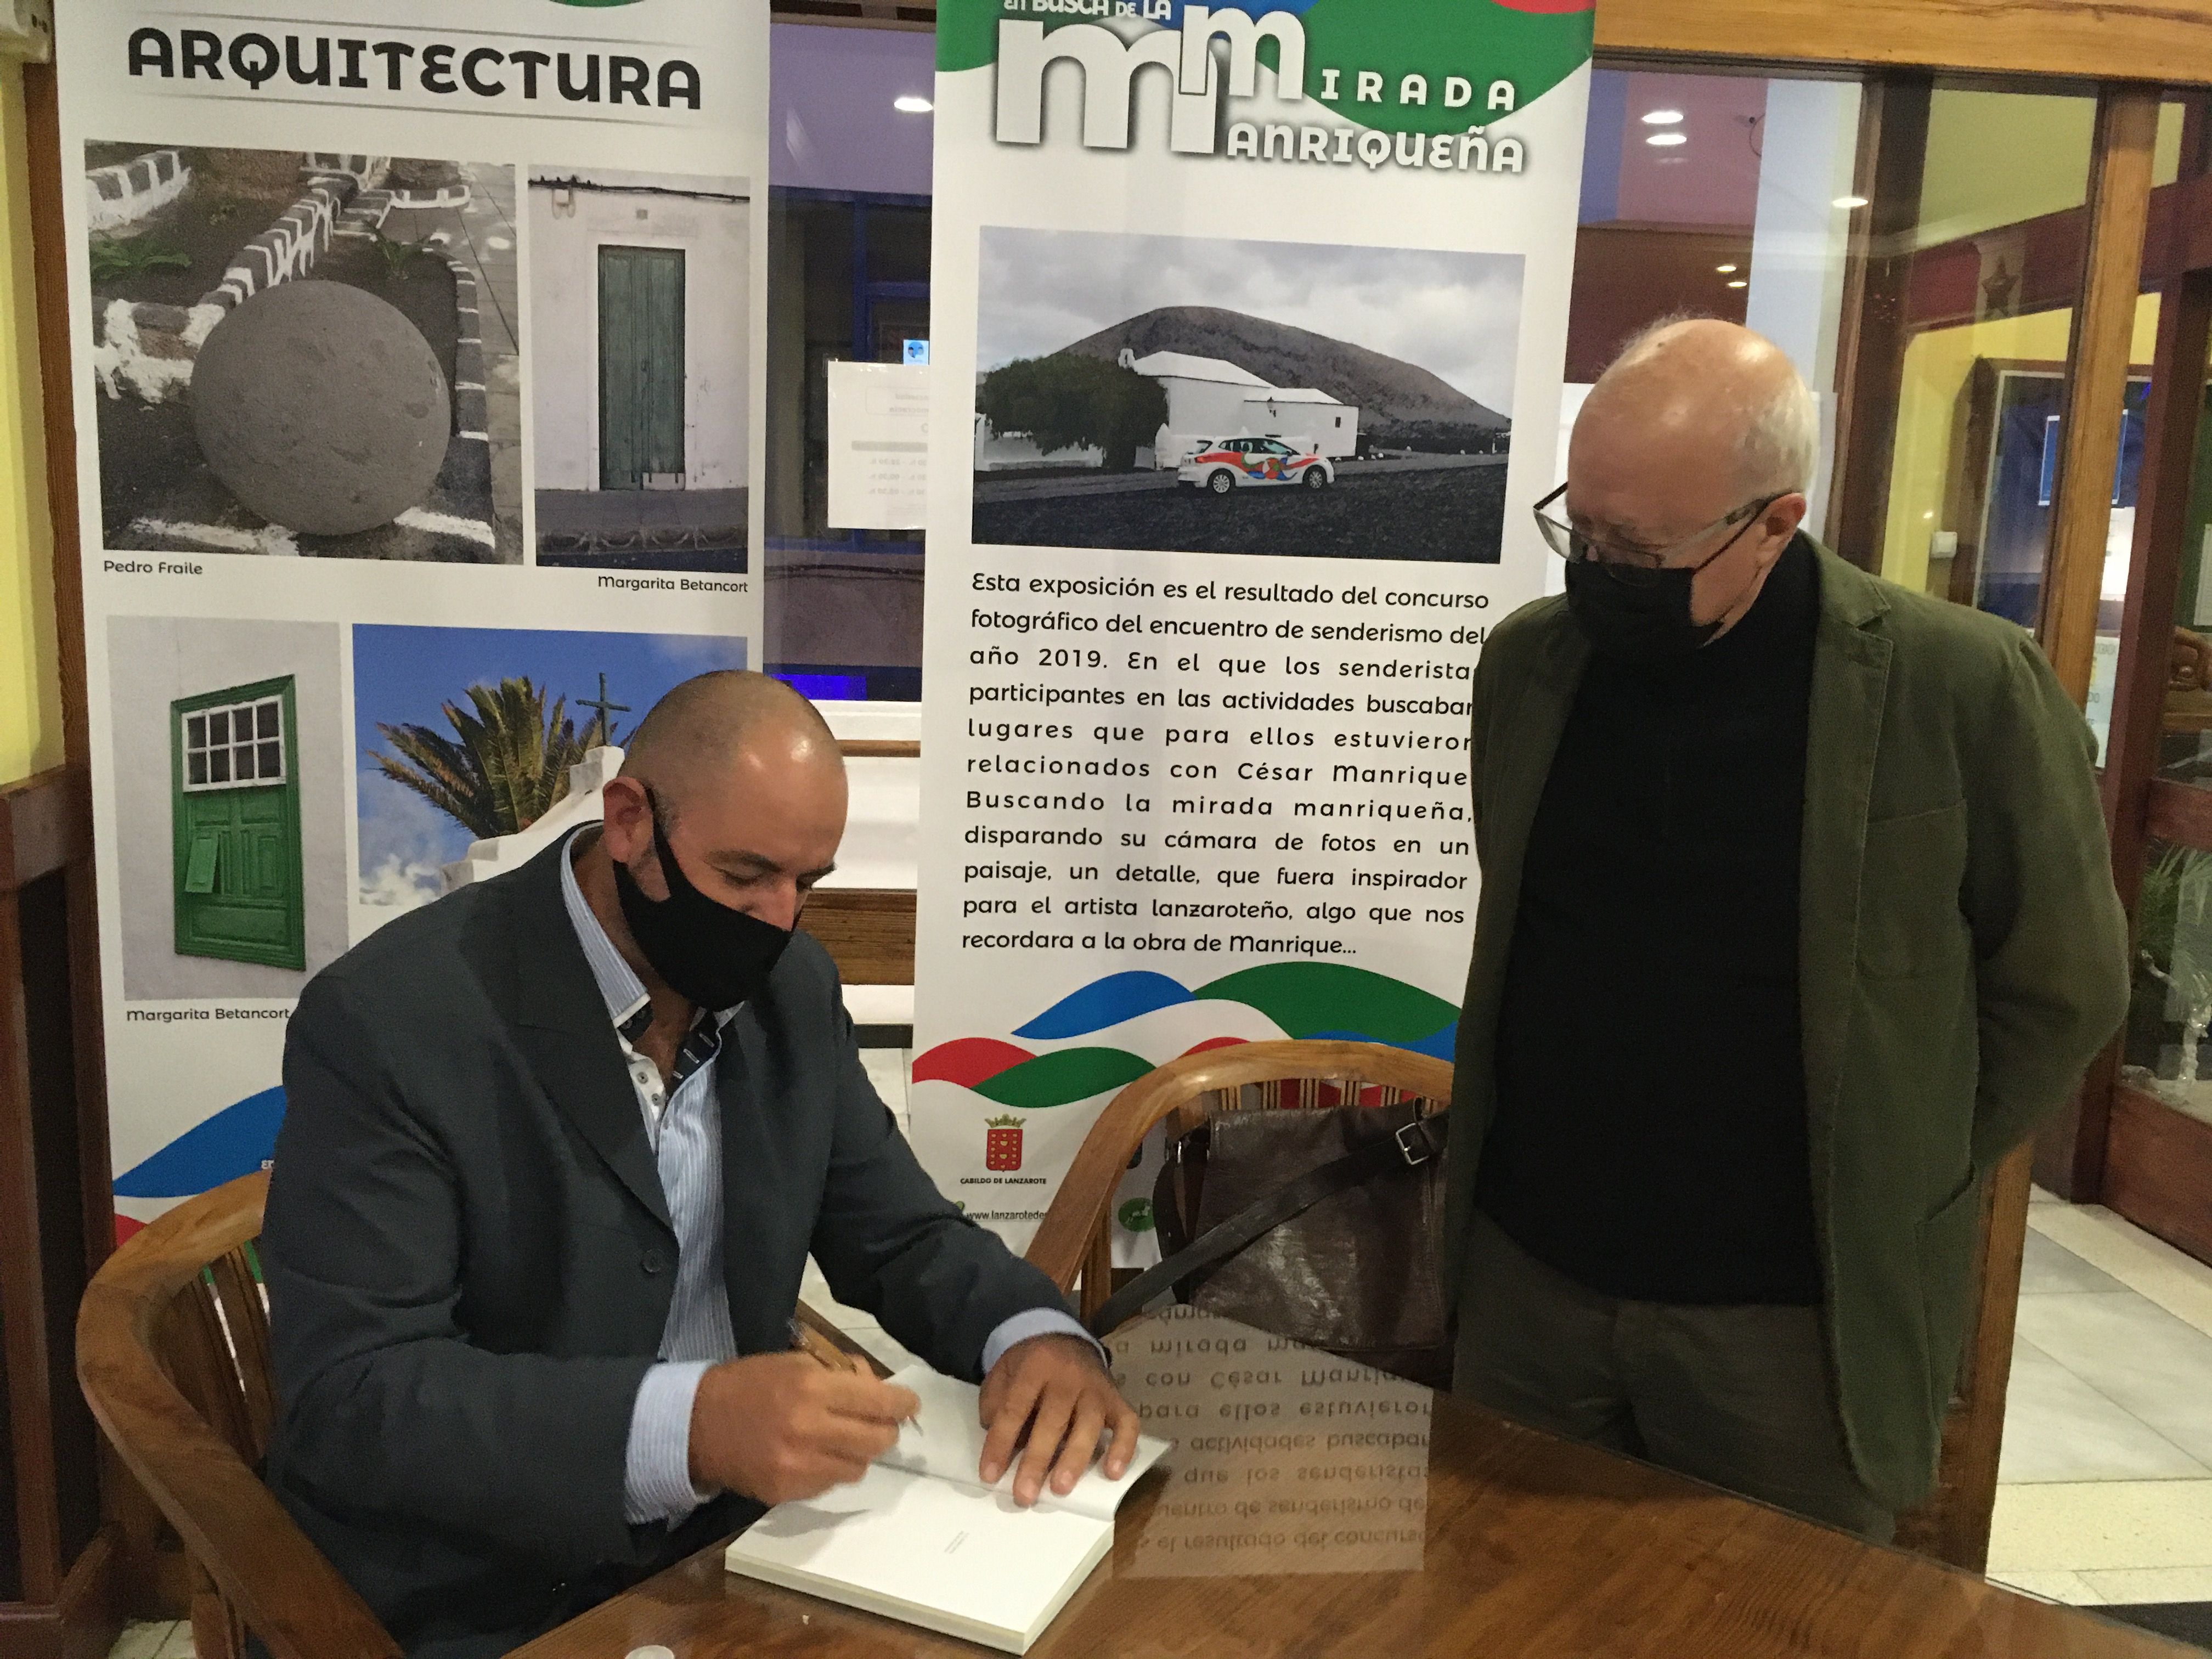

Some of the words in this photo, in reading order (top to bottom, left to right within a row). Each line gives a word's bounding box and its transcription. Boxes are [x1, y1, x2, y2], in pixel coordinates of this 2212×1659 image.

[1115, 1, 1136, 18] DE
[1143, 0, 1171, 20] LA
[127, 26, 702, 111] ARQUITECTURA
[103, 560, 154, 575] Pedro
[159, 561, 203, 575] Fraile
[598, 574, 675, 591] Margarita
[680, 579, 748, 593] Betancort
[972, 572, 1020, 592] Esta
[1029, 576, 1154, 599] exposición
[1163, 584, 1188, 599] es
[1195, 580, 1217, 600] el
[1224, 583, 1334, 603] resultado
[1341, 585, 1378, 606] del
[1385, 591, 1489, 609] concurso
[971, 608, 1098, 634] fotográfico
[1105, 613, 1143, 634] del
[1149, 619, 1268, 638] encuentro
[1275, 619, 1304, 639] de
[1311, 622, 1443, 644] senderismo
[1449, 625, 1486, 645] del
[969, 645, 1019, 665] año
[1039, 648, 1108, 669] 2019.
[1127, 651, 1158, 670] En
[1177, 653, 1200, 672] el
[1218, 658, 1266, 678] que
[1285, 656, 1320, 675] los
[1338, 659, 1470, 681] senderista
[969, 682, 1125, 707] participantes
[1137, 692, 1165, 707] en
[1178, 687, 1211, 708] las
[1222, 690, 1355, 712] actividades
[968, 718, 1073, 742] lugares
[1093, 726, 1144, 745] que
[1165, 728, 1228, 747] para
[1250, 726, 1314, 746] ellos
[967, 754, 1150, 777] relacionados
[1170, 764, 1217, 779] con
[1237, 761, 1313, 781] César
[1333, 764, 1468, 789] Manrique
[967, 791, 1104, 811] Buscando
[1126, 793, 1150, 812] la
[1172, 795, 1272, 816] mirada
[964, 825, 1103, 848] disparando
[1120, 833, 1146, 847] su
[1164, 830, 1256, 850] cámara
[1274, 832, 1304, 851] de
[1321, 833, 1376, 852] fotos
[1393, 839, 1421, 853] en
[1440, 840, 1469, 856] un
[964, 860, 1052, 883] paisaje,
[1069, 866, 1098, 881] un
[1115, 863, 1200, 885] detalle,
[1217, 870, 1260, 888] que
[1277, 866, 1334, 886] fuera
[1352, 867, 1468, 891] inspirador
[963, 900, 1017, 918] para
[1031, 895, 1052, 914] el
[1064, 897, 1138, 916] artista
[1152, 898, 1293, 921] lanzaroteño,
[1306, 901, 1356, 924] algo
[1369, 907, 1412, 925] que
[1425, 909, 1464, 924] nos
[962, 930, 1074, 949] recordara
[1081, 935, 1096, 949] a
[1104, 931, 1125, 950] la
[1133, 933, 1186, 951] obra
[1193, 934, 1222, 952] de
[1229, 935, 1356, 957] Manrique...
[127, 1009, 210, 1023] Margarita
[216, 1008, 289, 1019] Betancort
